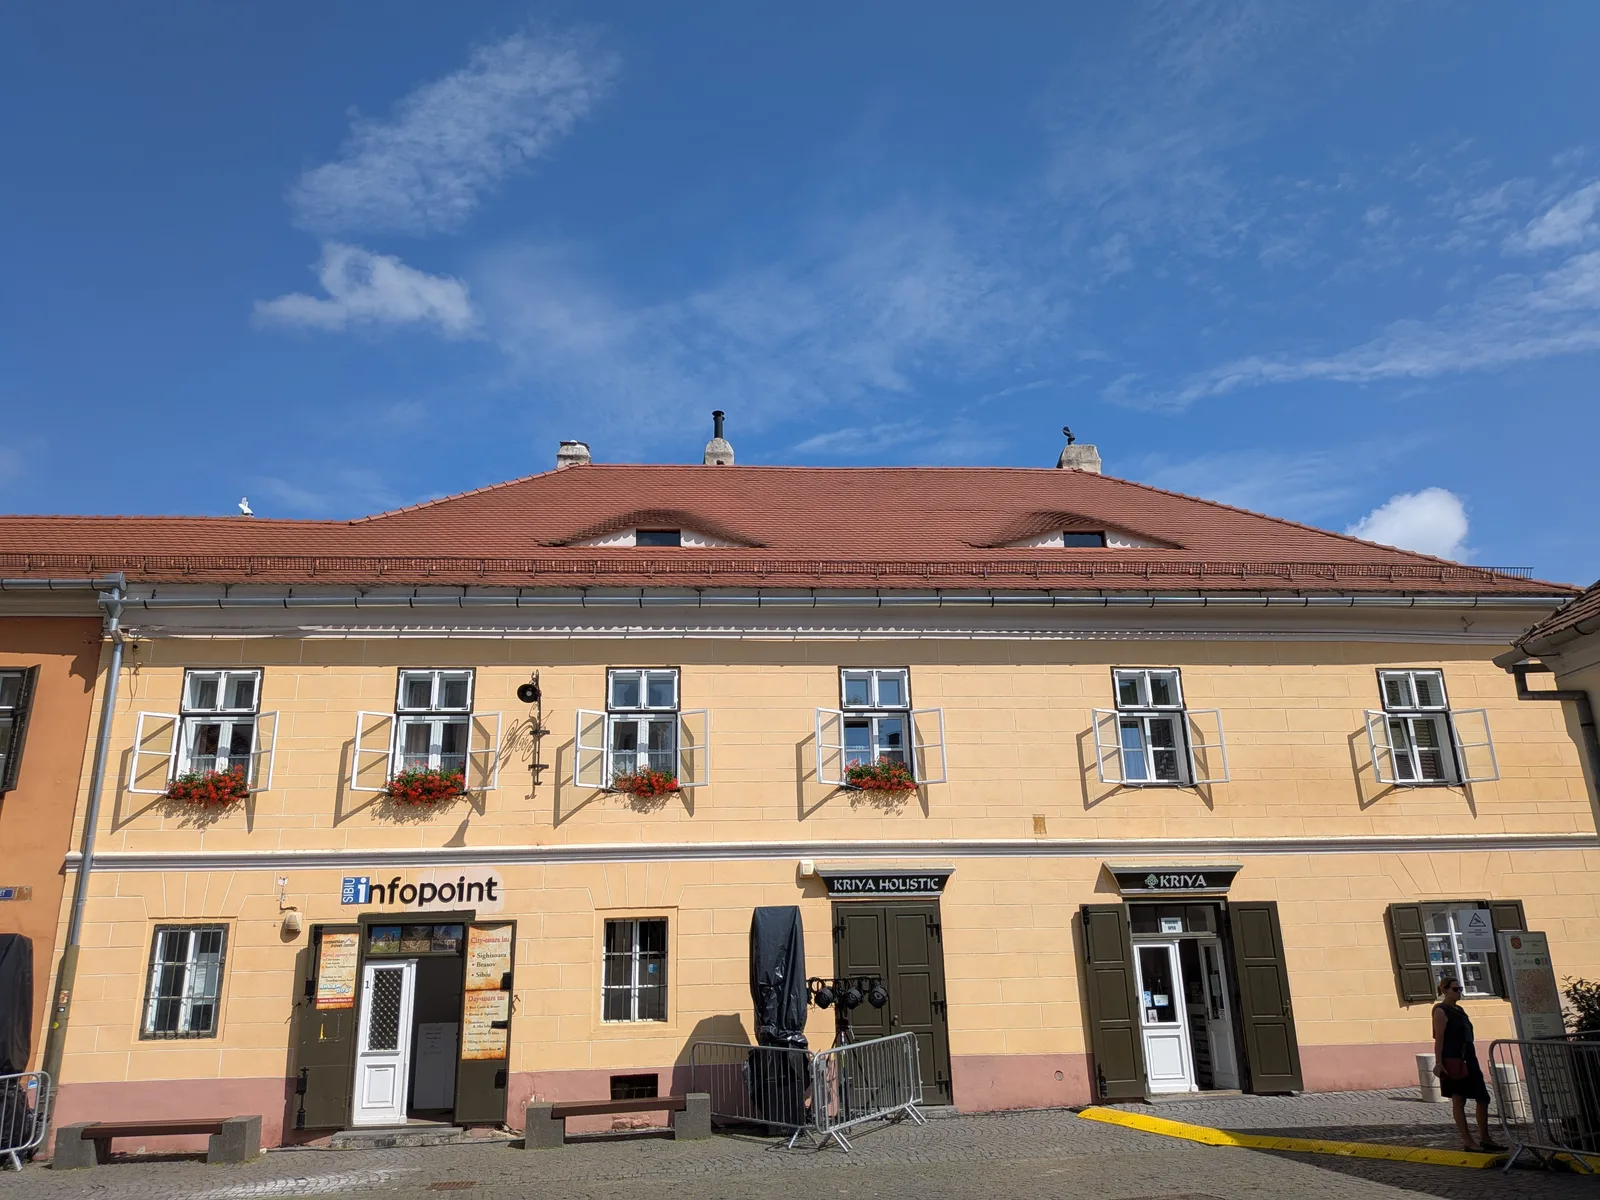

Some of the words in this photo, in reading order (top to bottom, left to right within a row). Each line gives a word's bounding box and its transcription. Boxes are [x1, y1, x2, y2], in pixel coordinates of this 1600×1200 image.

[833, 879, 876, 891] KRIYA
[879, 877, 939, 890] HOLISTIC
[1159, 874, 1207, 888] KRIYA
[342, 877, 355, 903] SIBIU
[357, 876, 498, 907] infopoint
[365, 980, 370, 989] 1
